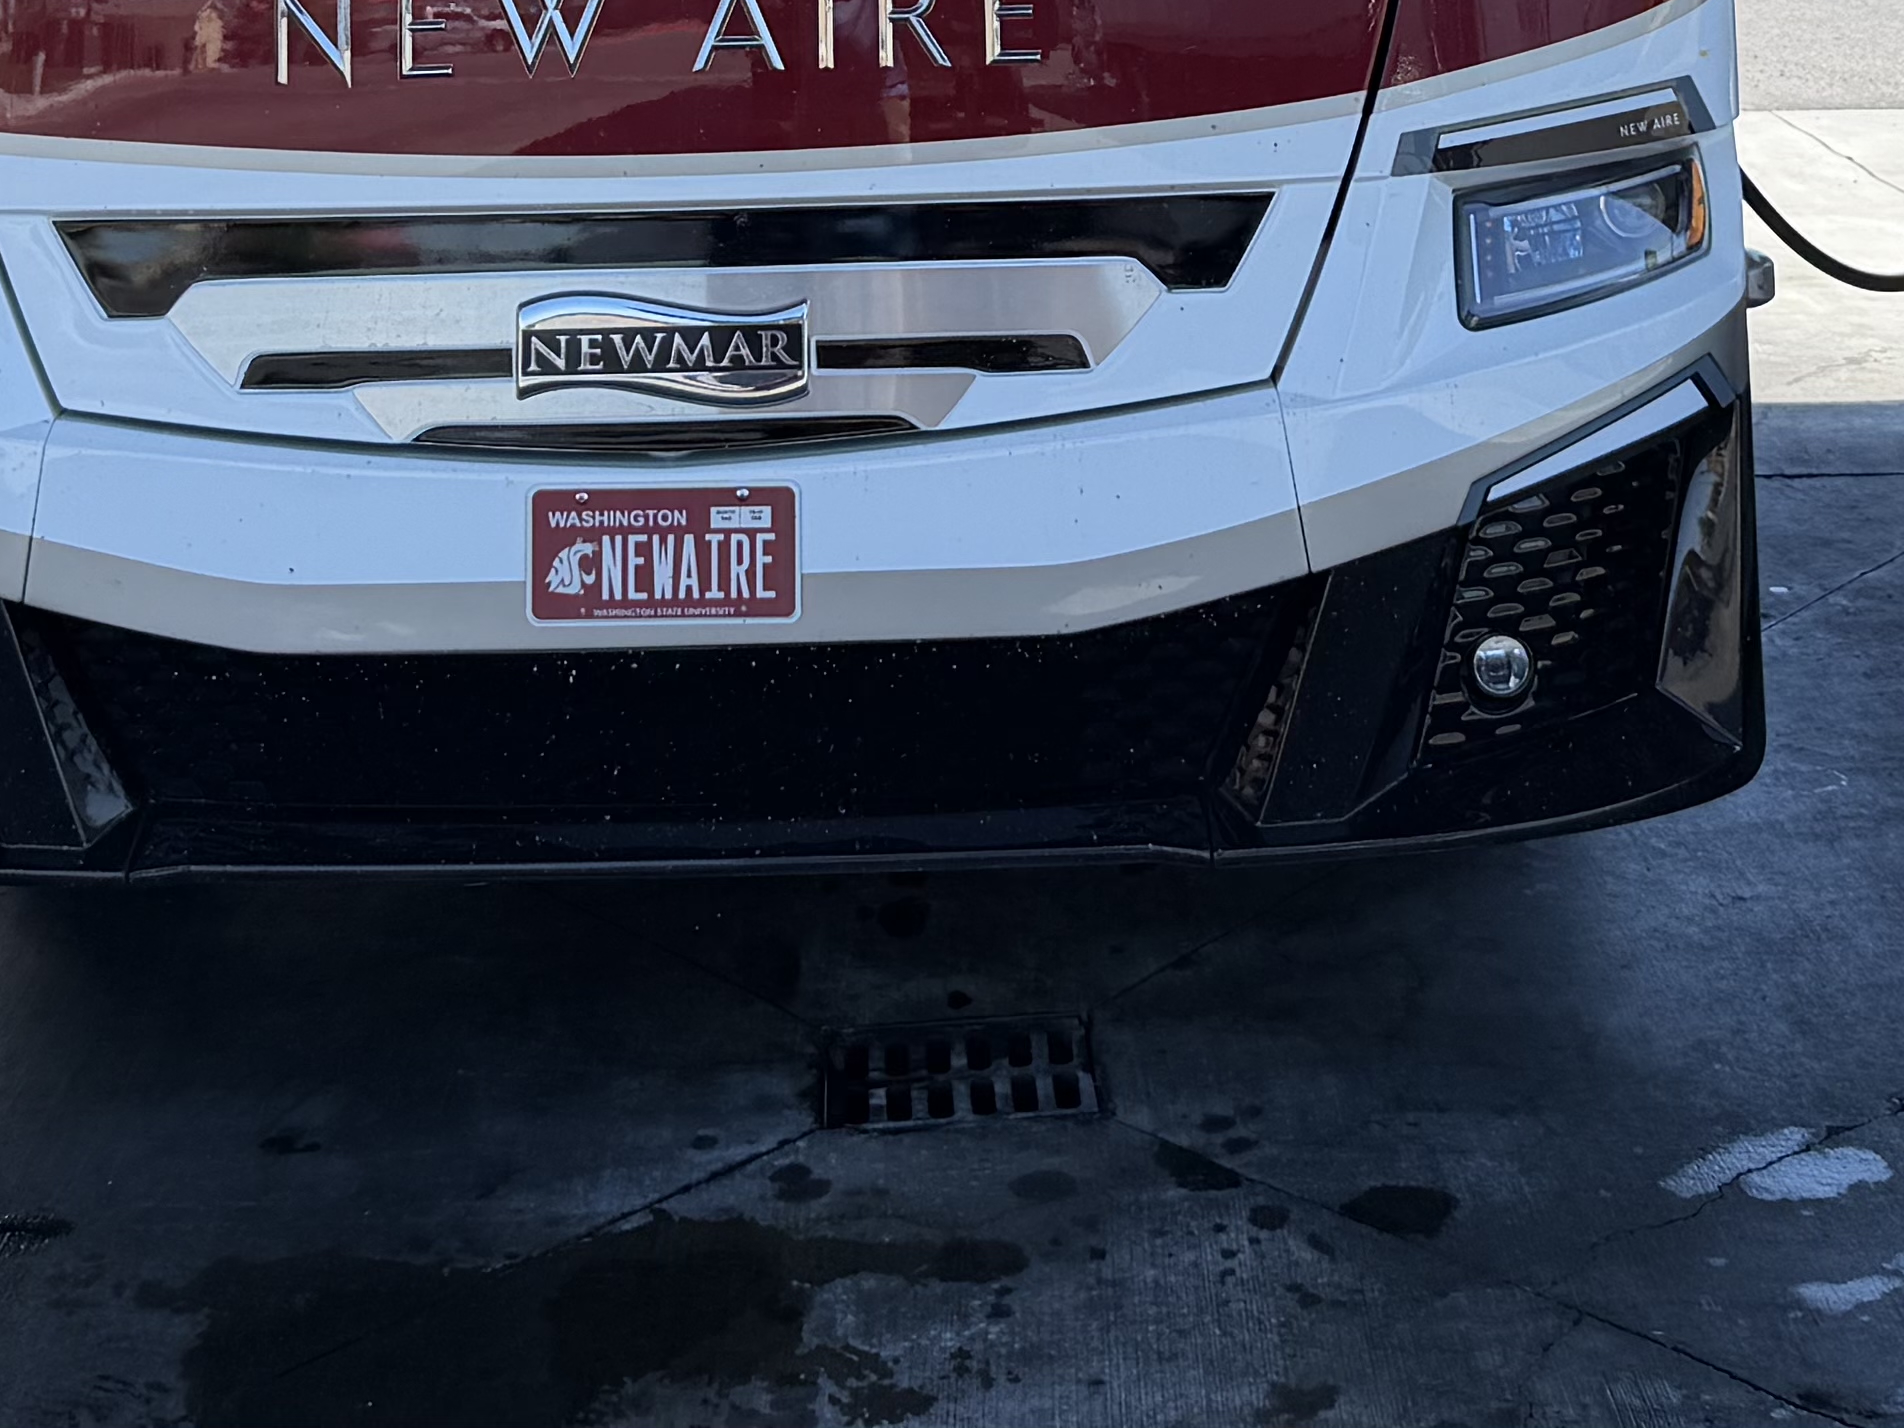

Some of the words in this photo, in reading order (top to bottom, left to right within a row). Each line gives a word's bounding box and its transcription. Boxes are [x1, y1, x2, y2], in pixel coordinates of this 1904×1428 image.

[1619, 119, 1647, 137] NEW
[1652, 112, 1680, 131] AIRE
[526, 330, 800, 373] NEWMAR
[548, 509, 687, 528] WASHINGTON
[601, 532, 777, 601] NEWAIRE
[593, 607, 655, 617] WASHINGTON
[657, 607, 682, 616] STATE
[684, 606, 736, 616] UNIVERSITY
